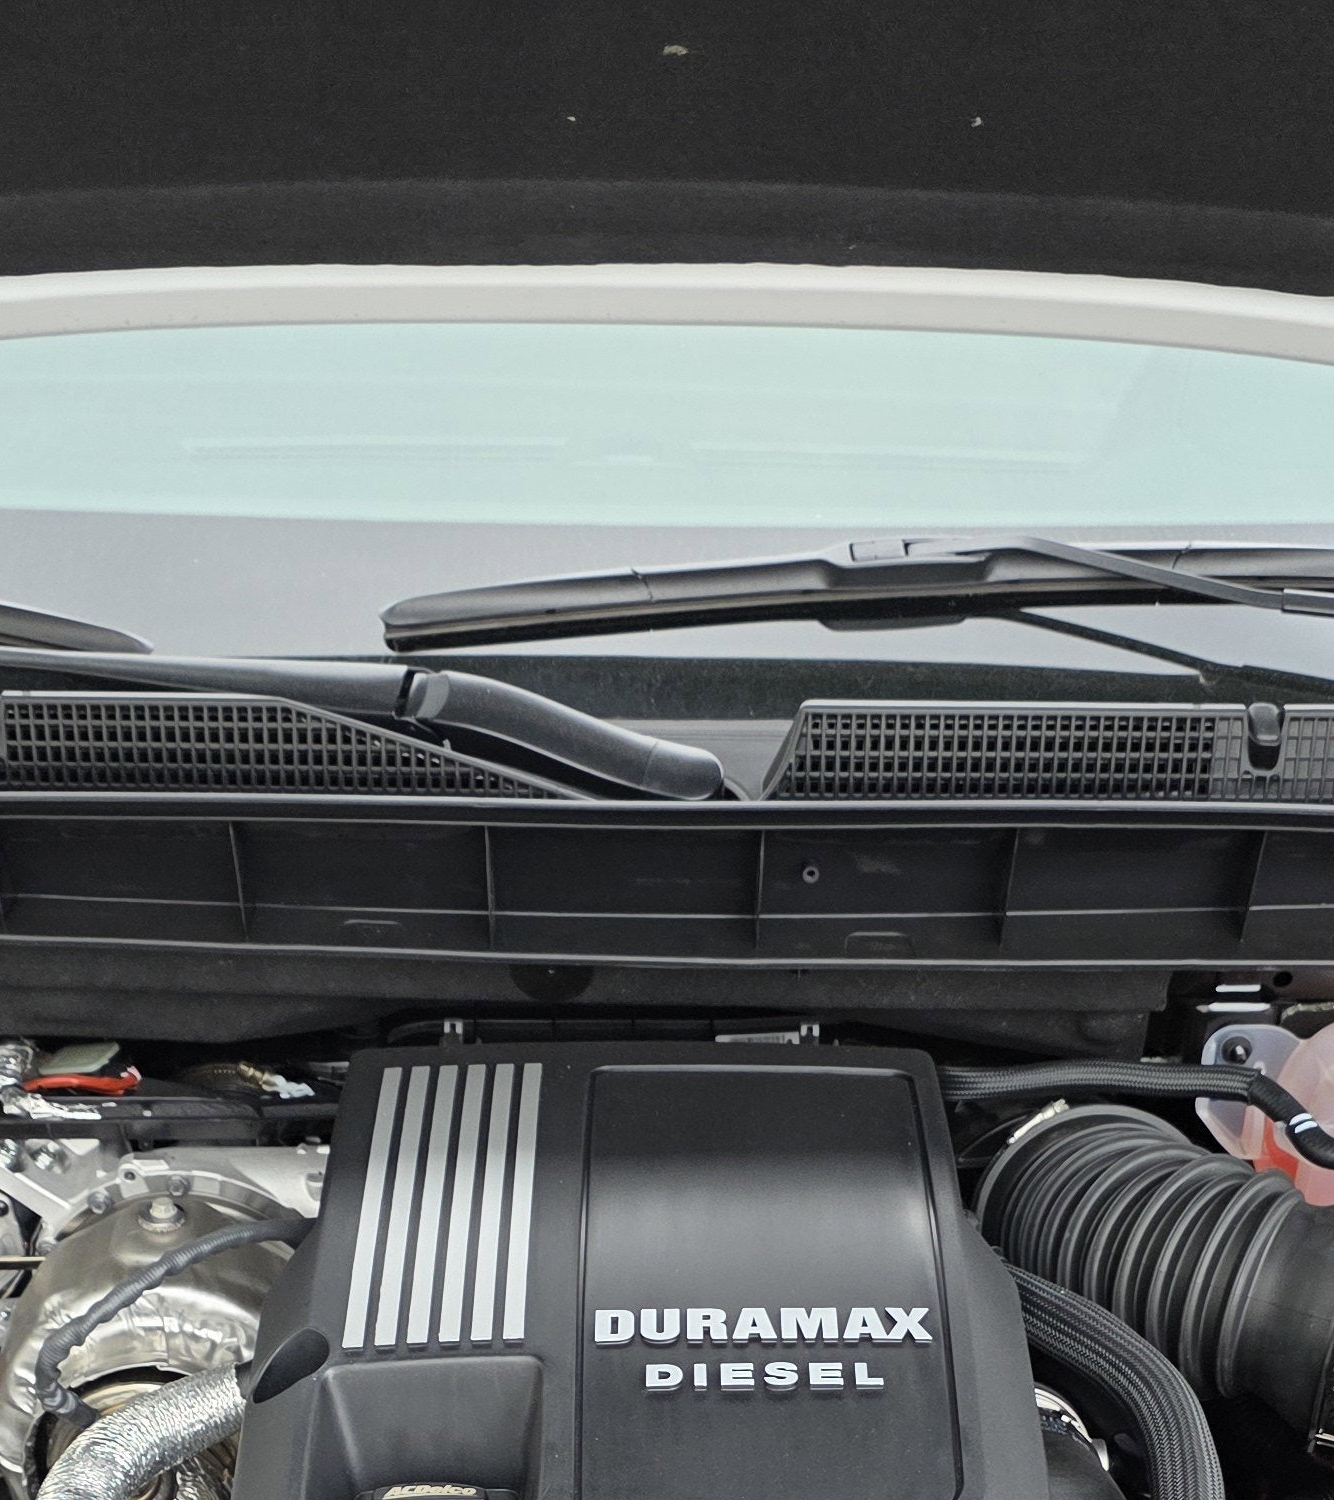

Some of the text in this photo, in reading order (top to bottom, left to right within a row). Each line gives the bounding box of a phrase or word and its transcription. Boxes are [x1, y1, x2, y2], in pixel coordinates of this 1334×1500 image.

[594, 1307, 933, 1343] DURAMAX
[645, 1362, 884, 1391] DIESEL
[382, 1484, 477, 1500] ACDelco
